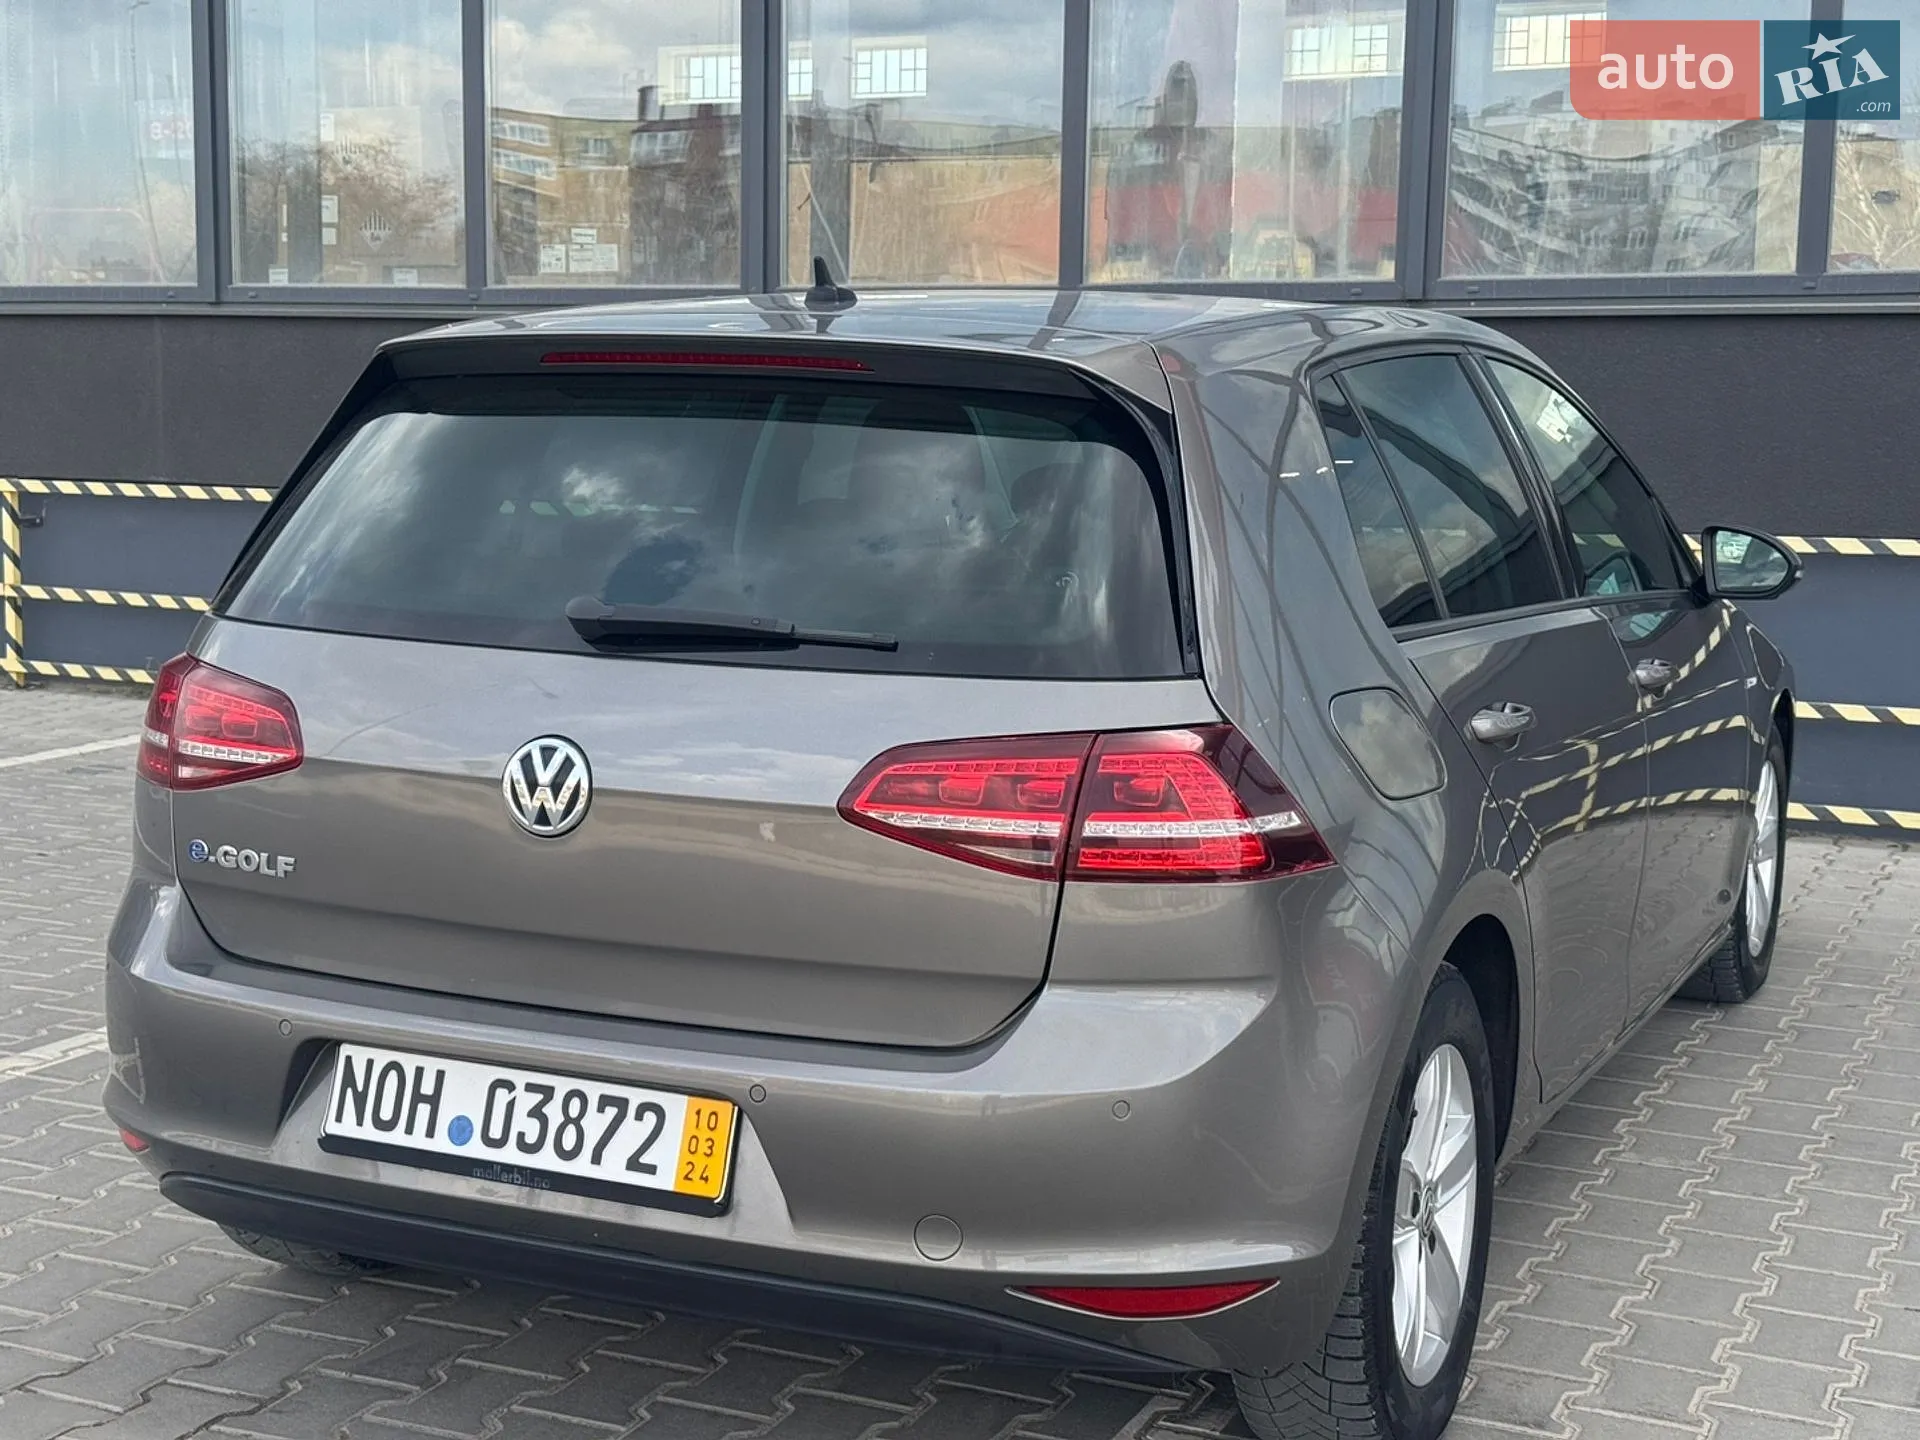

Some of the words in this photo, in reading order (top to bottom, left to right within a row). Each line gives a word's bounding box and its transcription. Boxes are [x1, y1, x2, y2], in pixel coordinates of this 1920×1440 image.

[334, 1054, 446, 1139] NOH
[480, 1078, 667, 1176] 03872
[694, 1108, 719, 1132] 10
[688, 1137, 715, 1159] 03
[682, 1160, 711, 1185] 24
